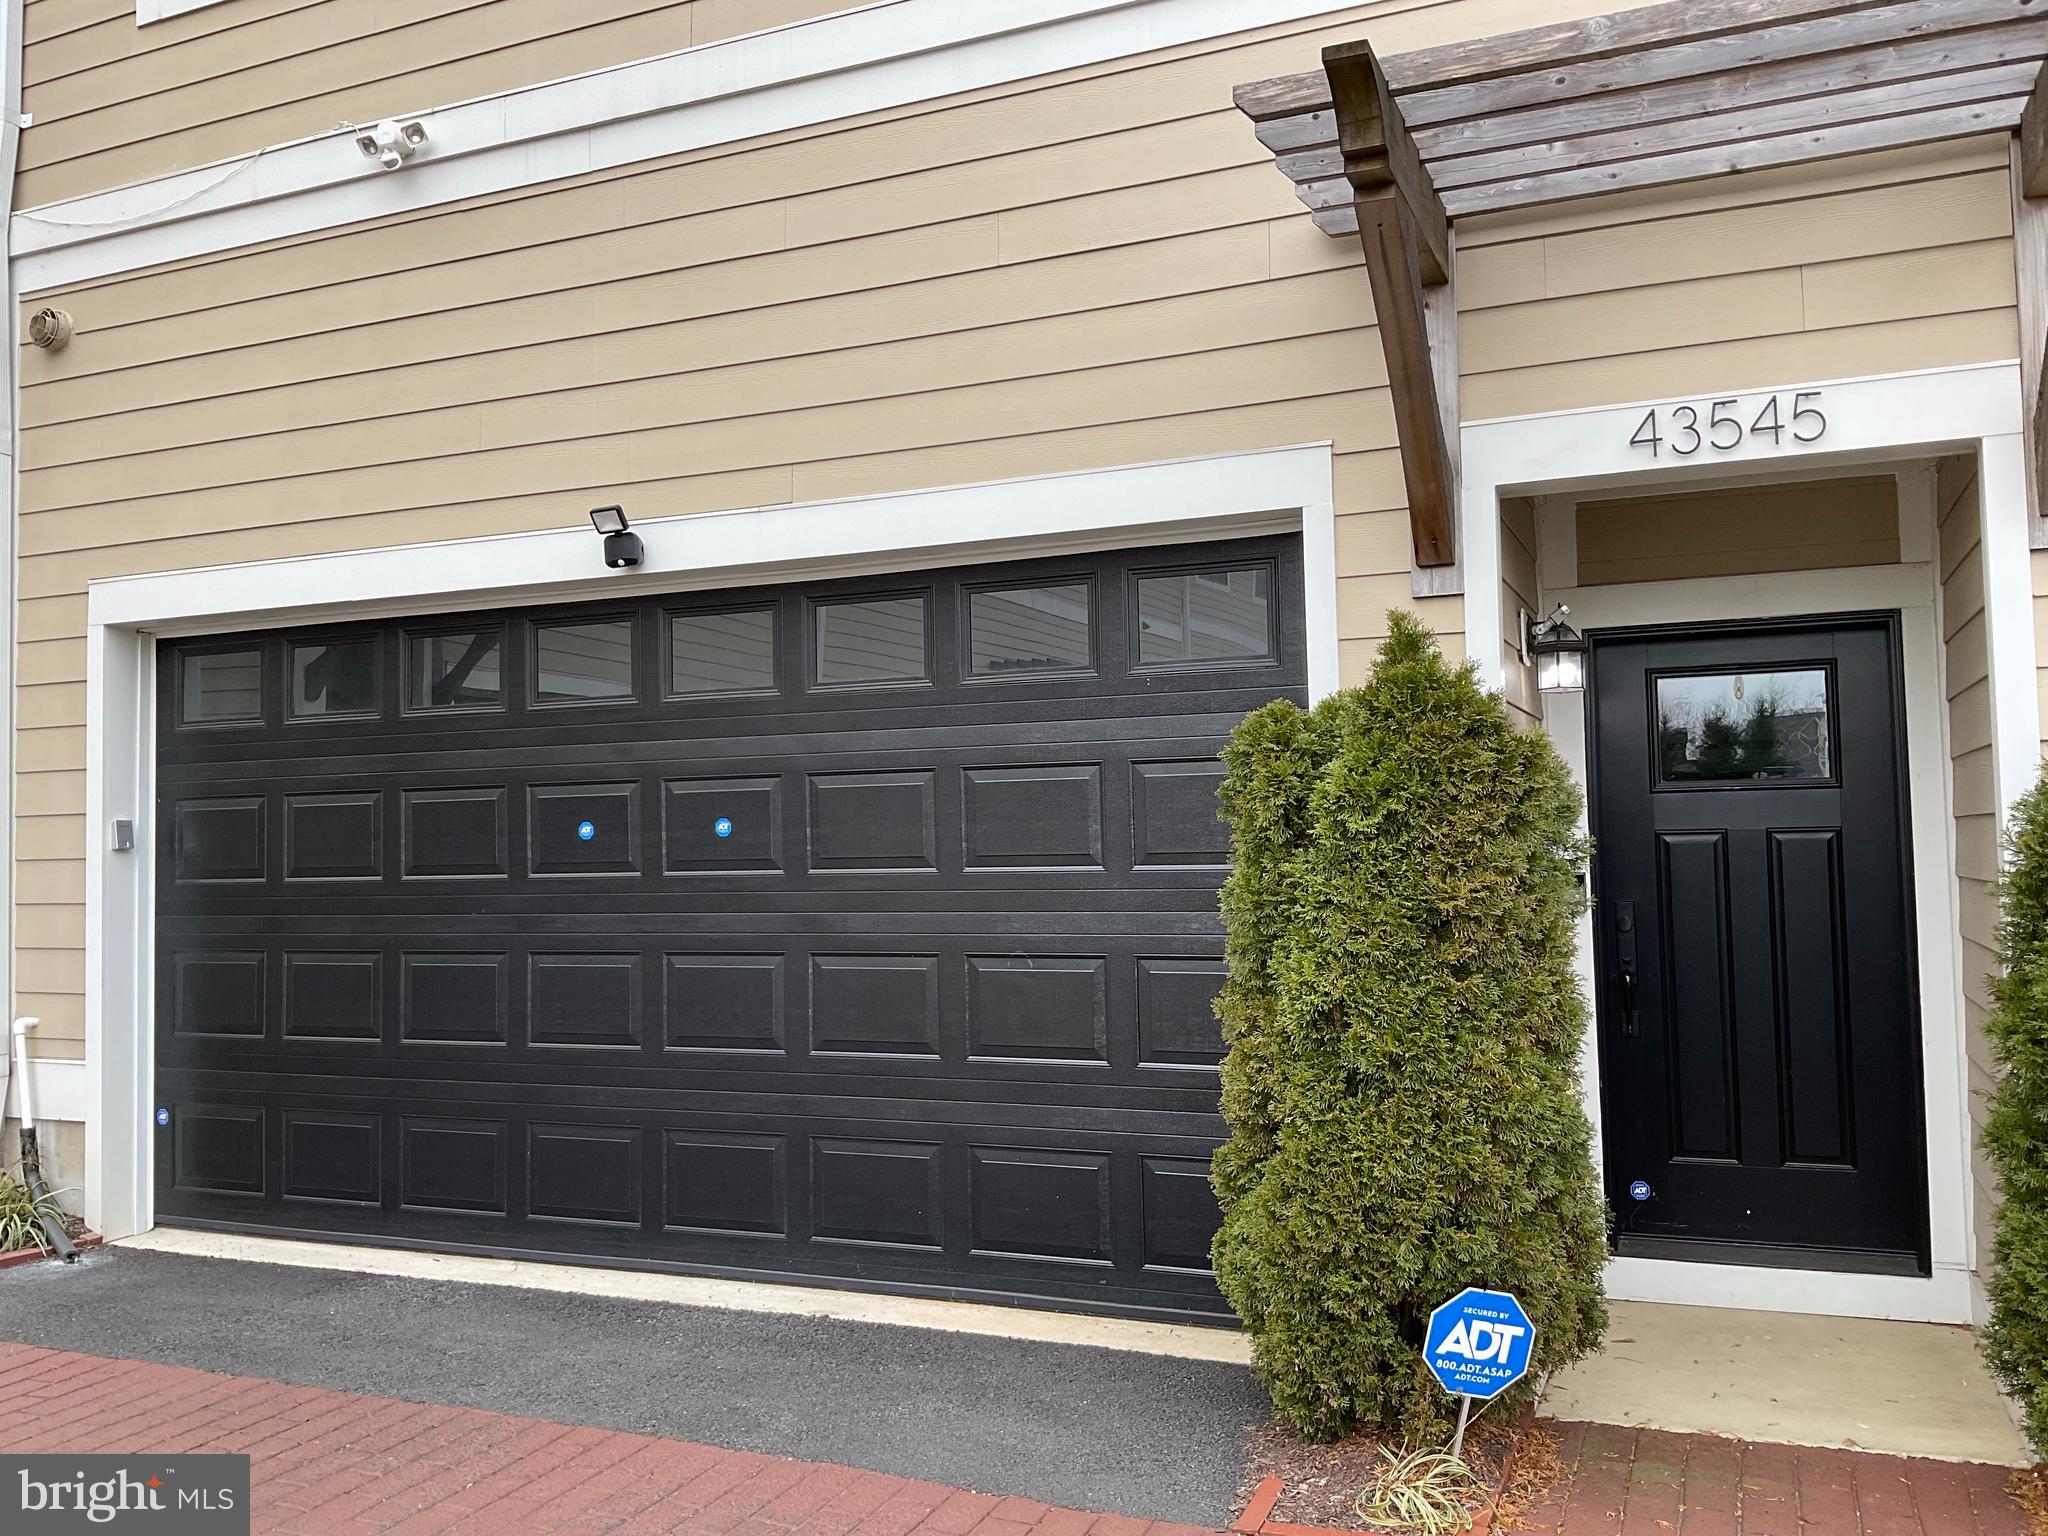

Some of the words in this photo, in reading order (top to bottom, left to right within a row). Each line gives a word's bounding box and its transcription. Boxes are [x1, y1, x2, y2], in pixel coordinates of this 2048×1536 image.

[1629, 391, 1827, 457] 43545
[1463, 1306, 1498, 1318] SECURED
[1499, 1312, 1510, 1320] BY
[1435, 1318, 1525, 1364] ADT
[1436, 1359, 1512, 1378] 800.ADT.ASAP
[1454, 1373, 1490, 1384] ADT.COM
